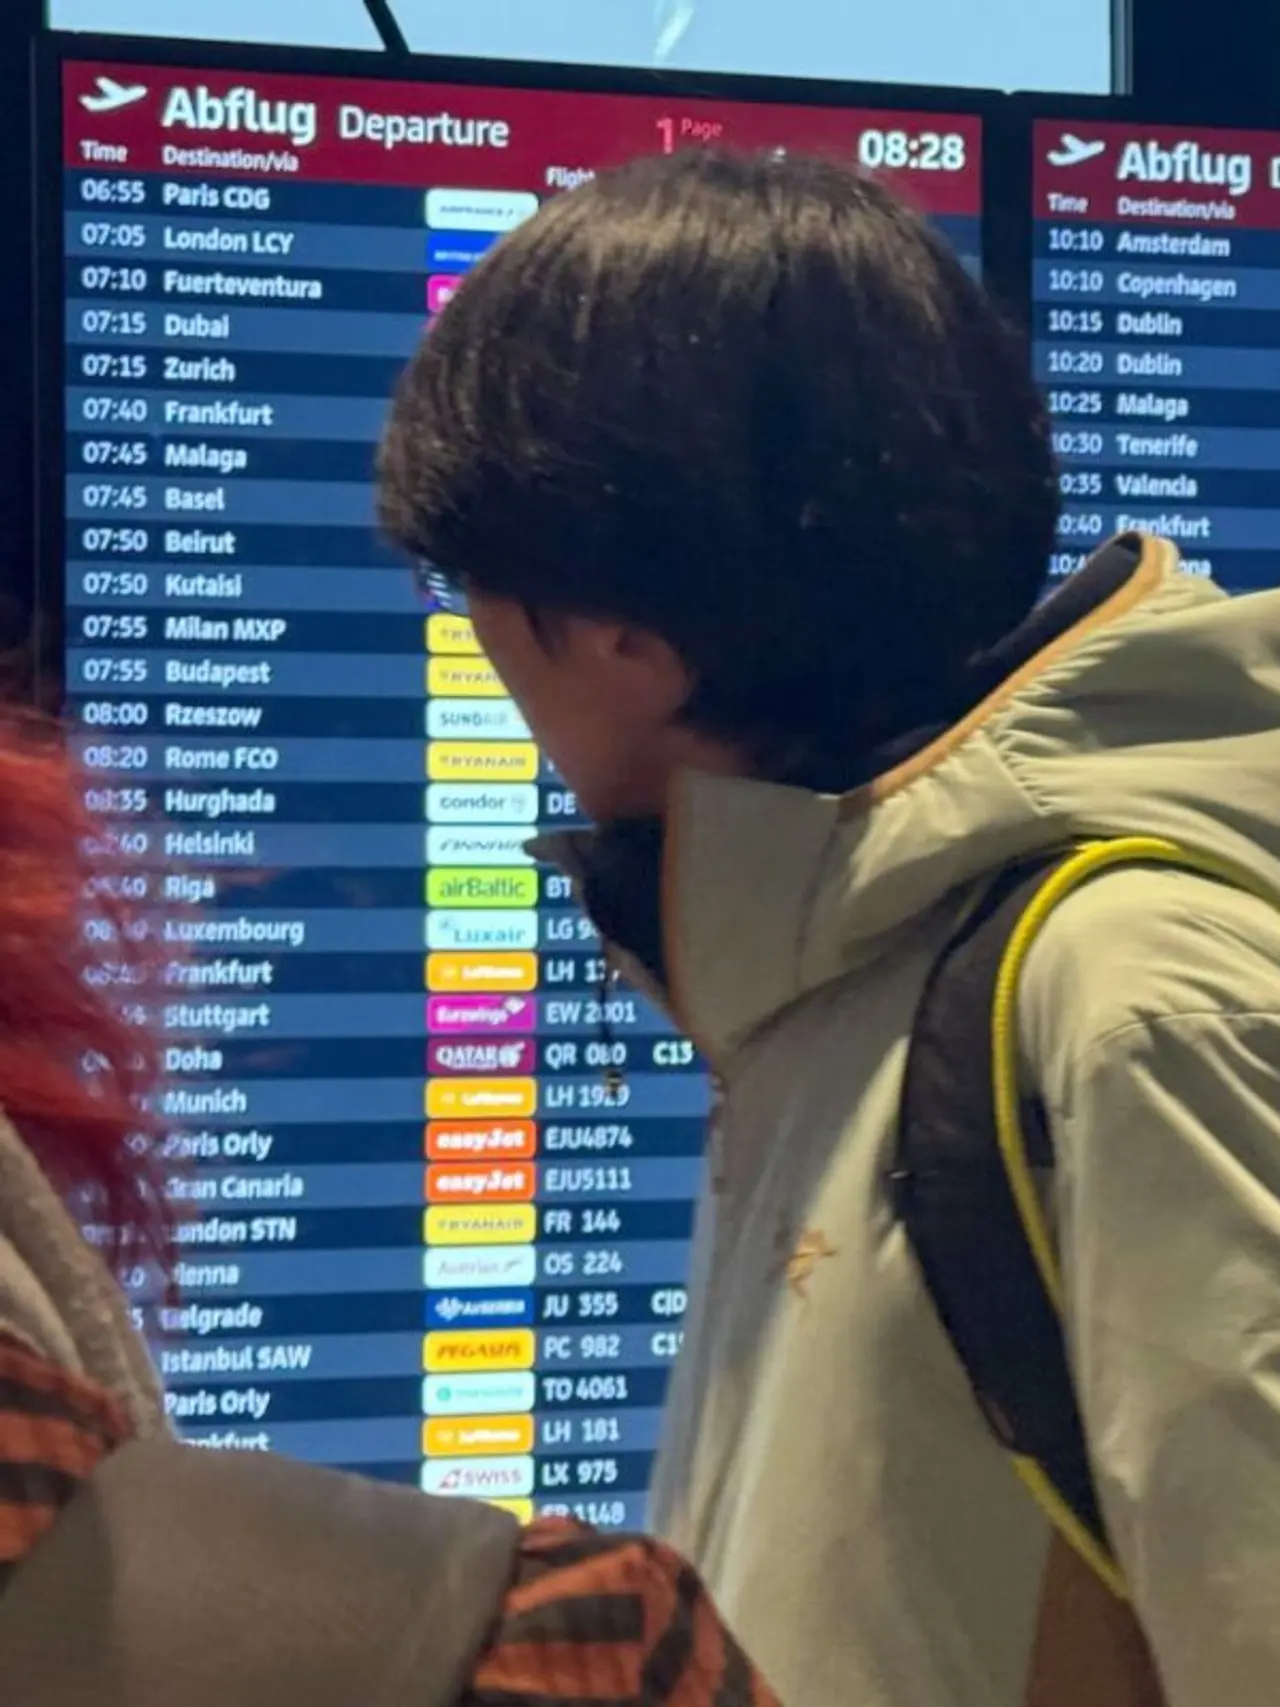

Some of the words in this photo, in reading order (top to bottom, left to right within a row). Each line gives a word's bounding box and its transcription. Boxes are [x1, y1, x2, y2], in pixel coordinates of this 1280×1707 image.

[162, 85, 317, 145] Abflug
[339, 105, 510, 150] Departure
[657, 118, 673, 153] 1
[681, 118, 721, 138] Page
[857, 129, 965, 172] 08:28
[80, 140, 128, 163] Time
[162, 144, 299, 173] Destination/via
[1116, 140, 1252, 197] Abflug
[82, 179, 145, 203] 06:55
[164, 183, 219, 208] Paris
[223, 187, 271, 210] CDG
[1047, 192, 1089, 214] Time
[1117, 195, 1236, 221] Destination/via
[82, 223, 146, 247] 07:05
[165, 227, 248, 251] London
[253, 232, 294, 255] LCY
[1049, 229, 1104, 252] 10:10
[1117, 231, 1231, 258] Amsterdam
[82, 266, 147, 290] 07:10
[164, 270, 322, 299] Fuerteventura
[1049, 269, 1104, 292] 10:10
[1117, 272, 1238, 302] Copenhagen
[83, 310, 147, 334] 07:15
[164, 314, 230, 338] Dubai
[1049, 310, 1103, 332] 10:15
[1116, 312, 1183, 336] Dublin
[83, 354, 147, 378] 07:15
[164, 357, 235, 381] Zurich
[1048, 351, 1103, 373] 10:20
[1116, 352, 1183, 376] Dublin
[83, 398, 147, 421] 07:40
[165, 401, 273, 426] Frankfurt
[1049, 392, 1103, 414] 10:25
[1116, 393, 1190, 421] Malaga
[83, 441, 147, 465] 07:45
[165, 444, 247, 473] Malaga
[1115, 432, 1198, 458] Tenerife
[83, 485, 147, 508] 07:45
[165, 487, 225, 511] Basel
[1115, 474, 1198, 498] Valencia
[84, 528, 148, 552] 07:50
[165, 530, 236, 554] Beirut
[84, 572, 148, 595] 07:50
[165, 573, 242, 598] Kutaisi
[83, 615, 147, 638] 07:55
[165, 615, 229, 639] Milan
[233, 618, 286, 641] MXP
[84, 659, 147, 682] 07:55
[165, 659, 271, 688] Budapest
[84, 702, 148, 725] 08:00
[165, 703, 262, 727] Rzeszow
[84, 745, 148, 769] 08:20
[165, 746, 230, 770] Rome
[234, 746, 279, 770] FCO
[165, 789, 275, 818] Hurghada
[439, 792, 505, 811] condor
[546, 791, 577, 815] DE
[164, 831, 256, 856] Helsinki
[164, 874, 216, 904] Riga
[439, 876, 526, 899] airBaltic
[546, 875, 572, 899] BT
[163, 916, 305, 947] Luxembourg
[454, 925, 525, 944] Luxair
[163, 1003, 271, 1033] Stuttgart
[164, 1046, 223, 1071] Doha
[162, 1088, 247, 1114] Munich
[223, 1132, 272, 1161] Orly
[436, 1127, 526, 1152] easyJet
[544, 1126, 633, 1150] EJU4874
[221, 1174, 304, 1199] Canaria
[435, 1169, 526, 1195] easyJet
[544, 1167, 632, 1193] EJU5111
[251, 1217, 297, 1242] STN
[544, 1210, 573, 1234] FR
[581, 1209, 622, 1234] 144
[543, 1252, 574, 1276] OS
[582, 1250, 624, 1275] 224
[161, 1346, 254, 1374] Istanbul
[257, 1345, 312, 1370] SAW
[543, 1335, 572, 1360] PC
[580, 1333, 621, 1358] 982
[163, 1391, 218, 1417] Paris
[221, 1389, 271, 1419] Orly
[542, 1376, 573, 1402] TO
[576, 1375, 628, 1400] 4061
[542, 1420, 573, 1445] LH
[581, 1417, 621, 1443] 181
[464, 1467, 524, 1485] SWISS
[542, 1462, 570, 1487] LX
[577, 1459, 619, 1485] 975
